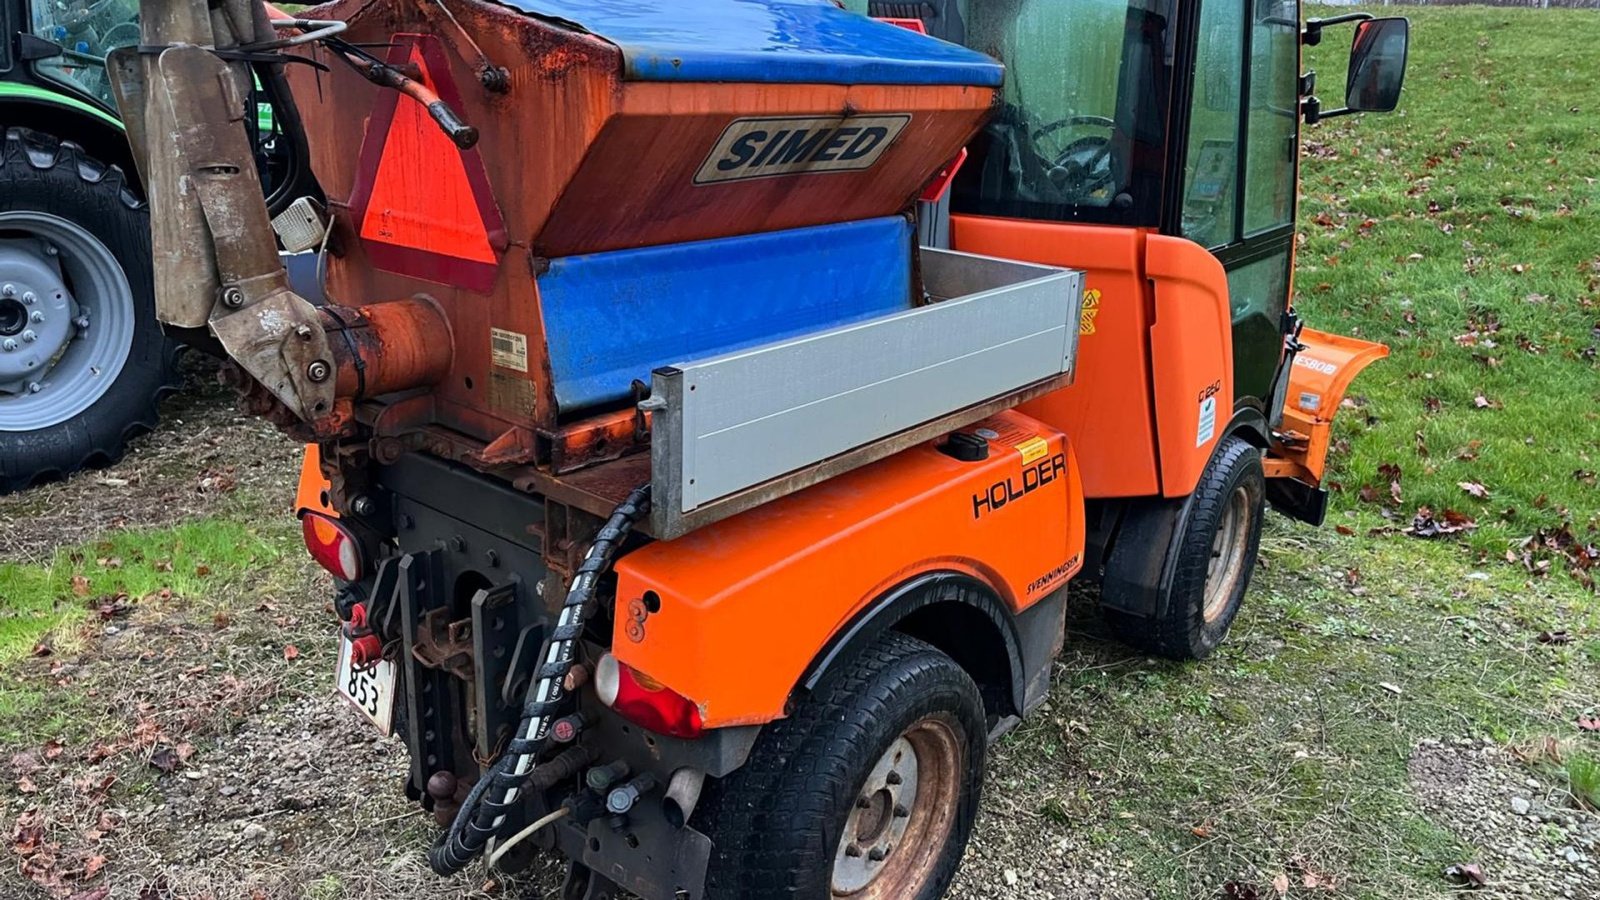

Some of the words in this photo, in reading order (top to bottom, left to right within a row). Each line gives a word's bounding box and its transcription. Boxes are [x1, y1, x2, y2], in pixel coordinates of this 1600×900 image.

[717, 126, 888, 171] SIMED
[972, 452, 1067, 519] HOLDER
[1026, 552, 1079, 595] SVENNINGSEN
[348, 667, 379, 716] 853
